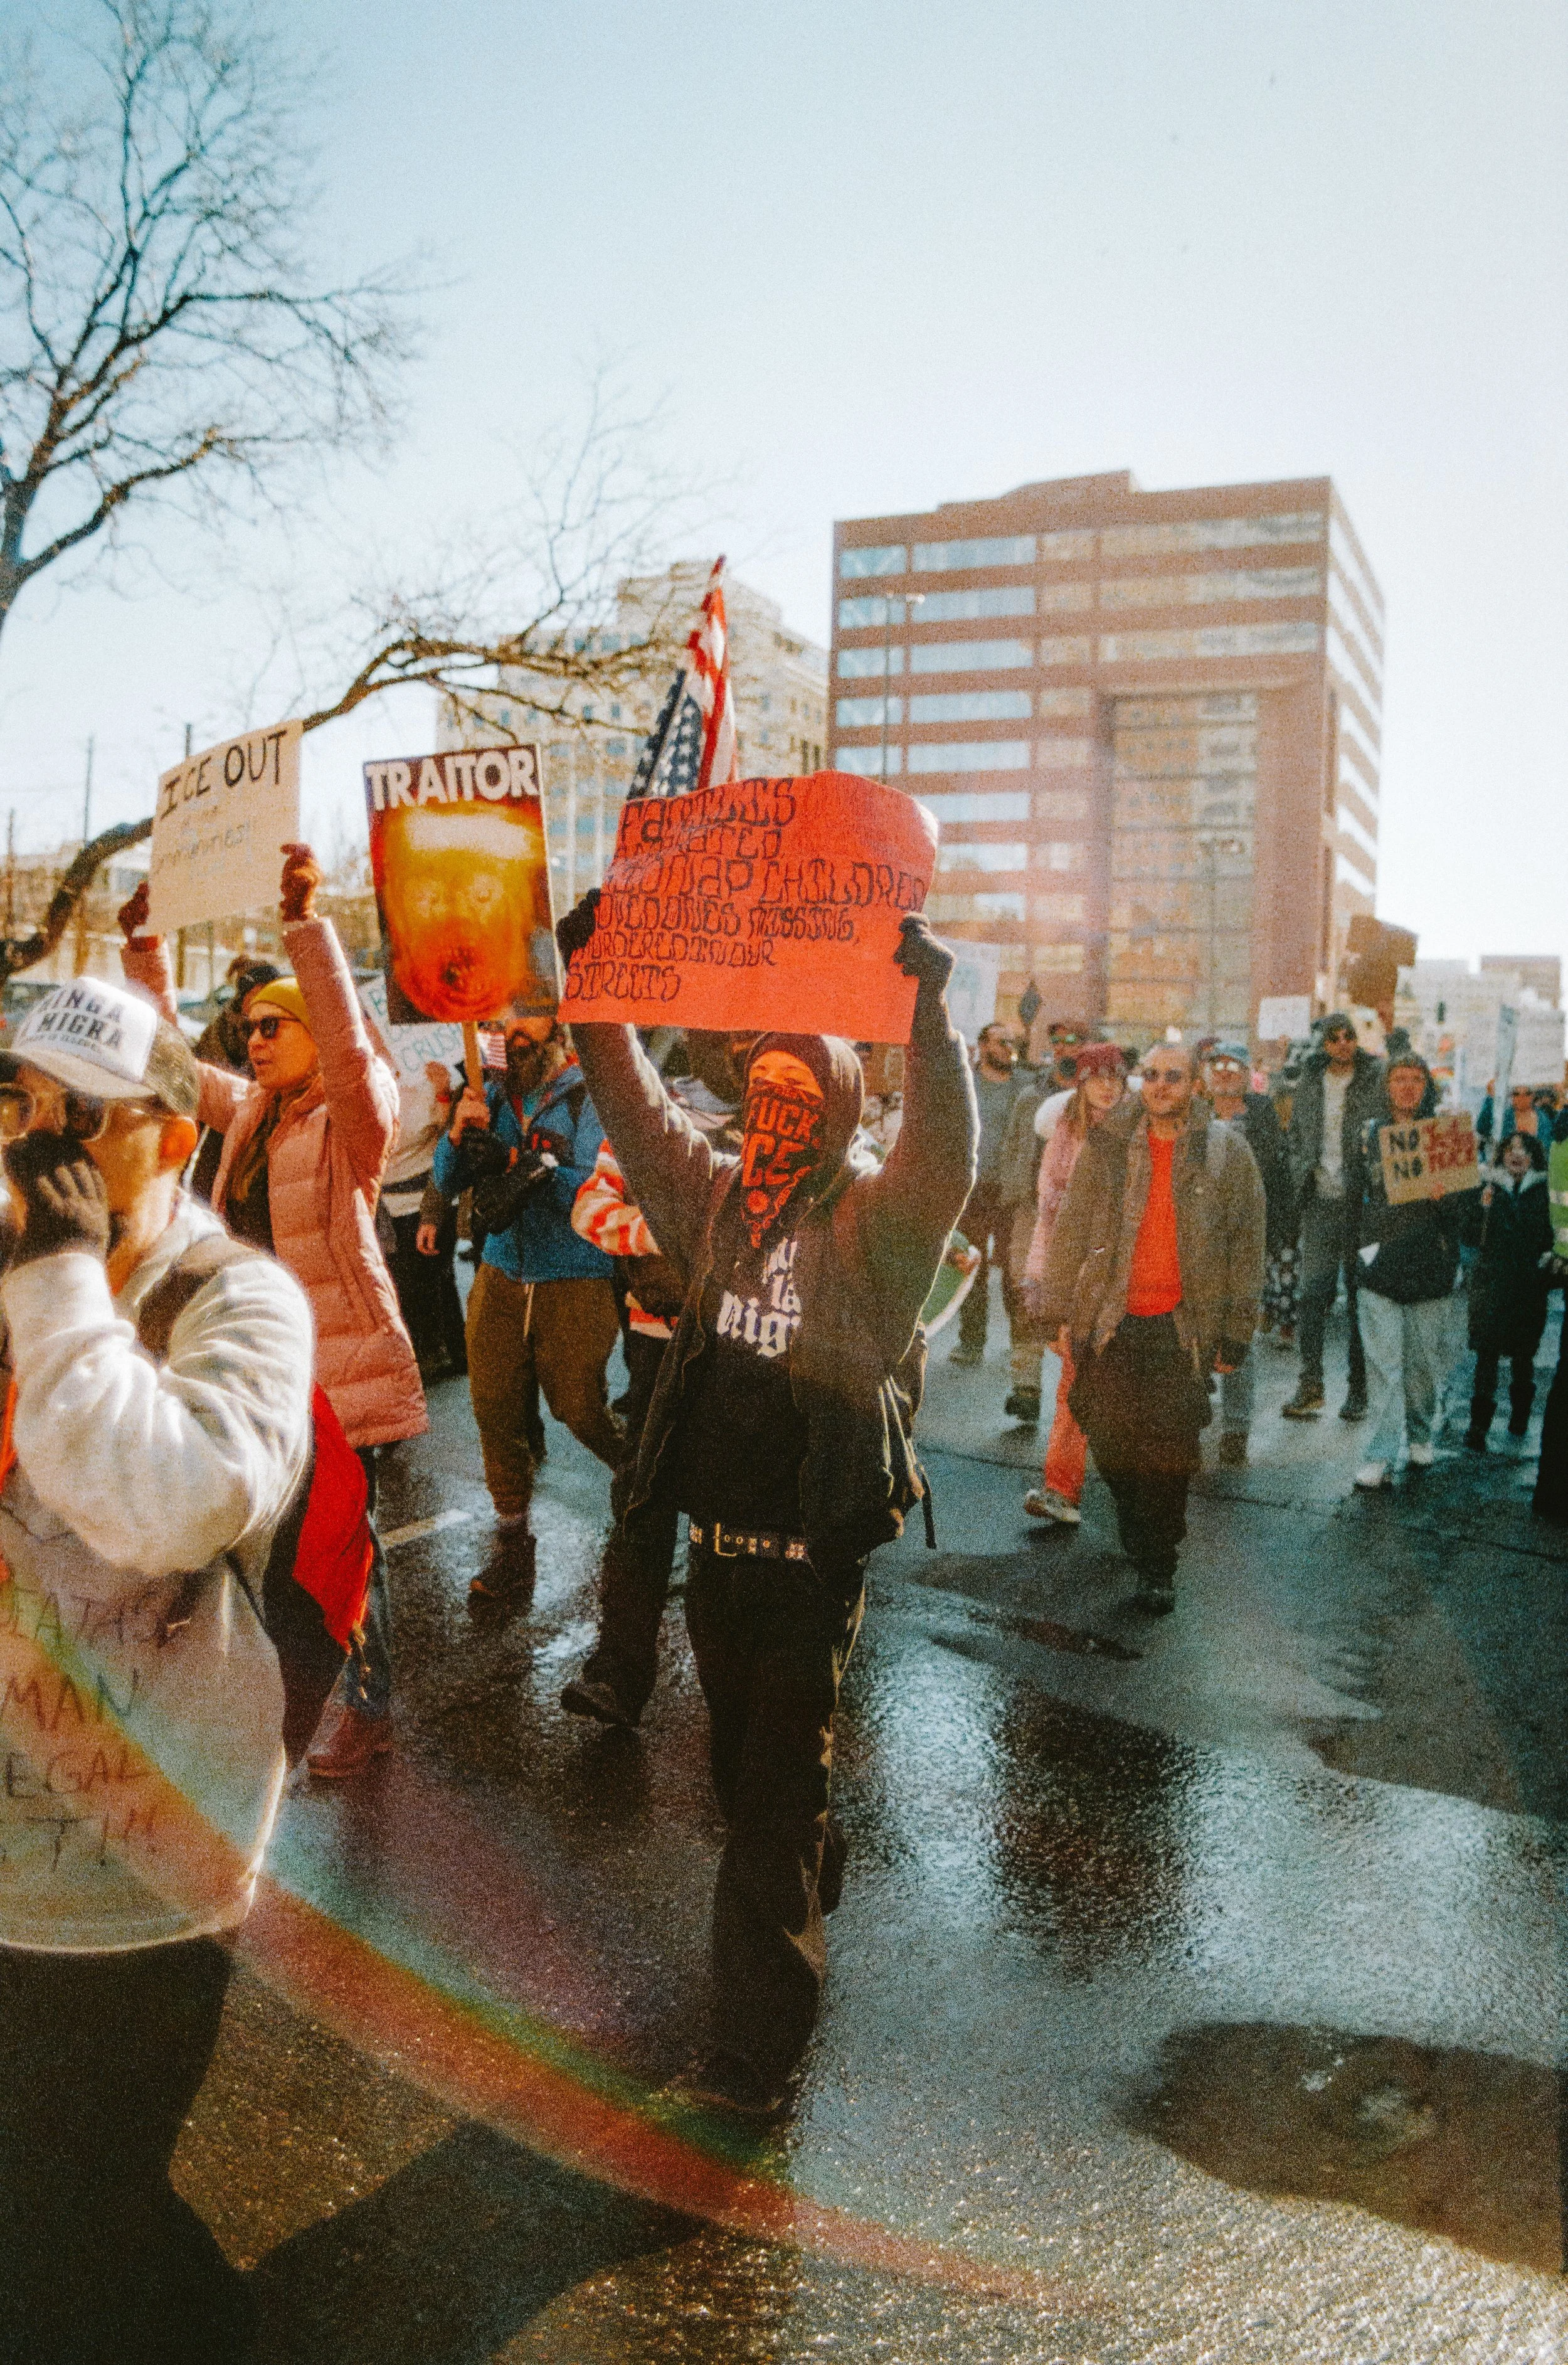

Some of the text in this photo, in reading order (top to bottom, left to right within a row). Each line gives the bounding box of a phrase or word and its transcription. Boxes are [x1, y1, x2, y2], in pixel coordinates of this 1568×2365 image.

[161, 755, 212, 821] ICE
[224, 728, 288, 789] OUT
[365, 749, 541, 811] TRAITOR
[564, 959, 682, 1004] STREETS
[1388, 1128, 1421, 1156] NO
[1392, 1156, 1423, 1184] NO
